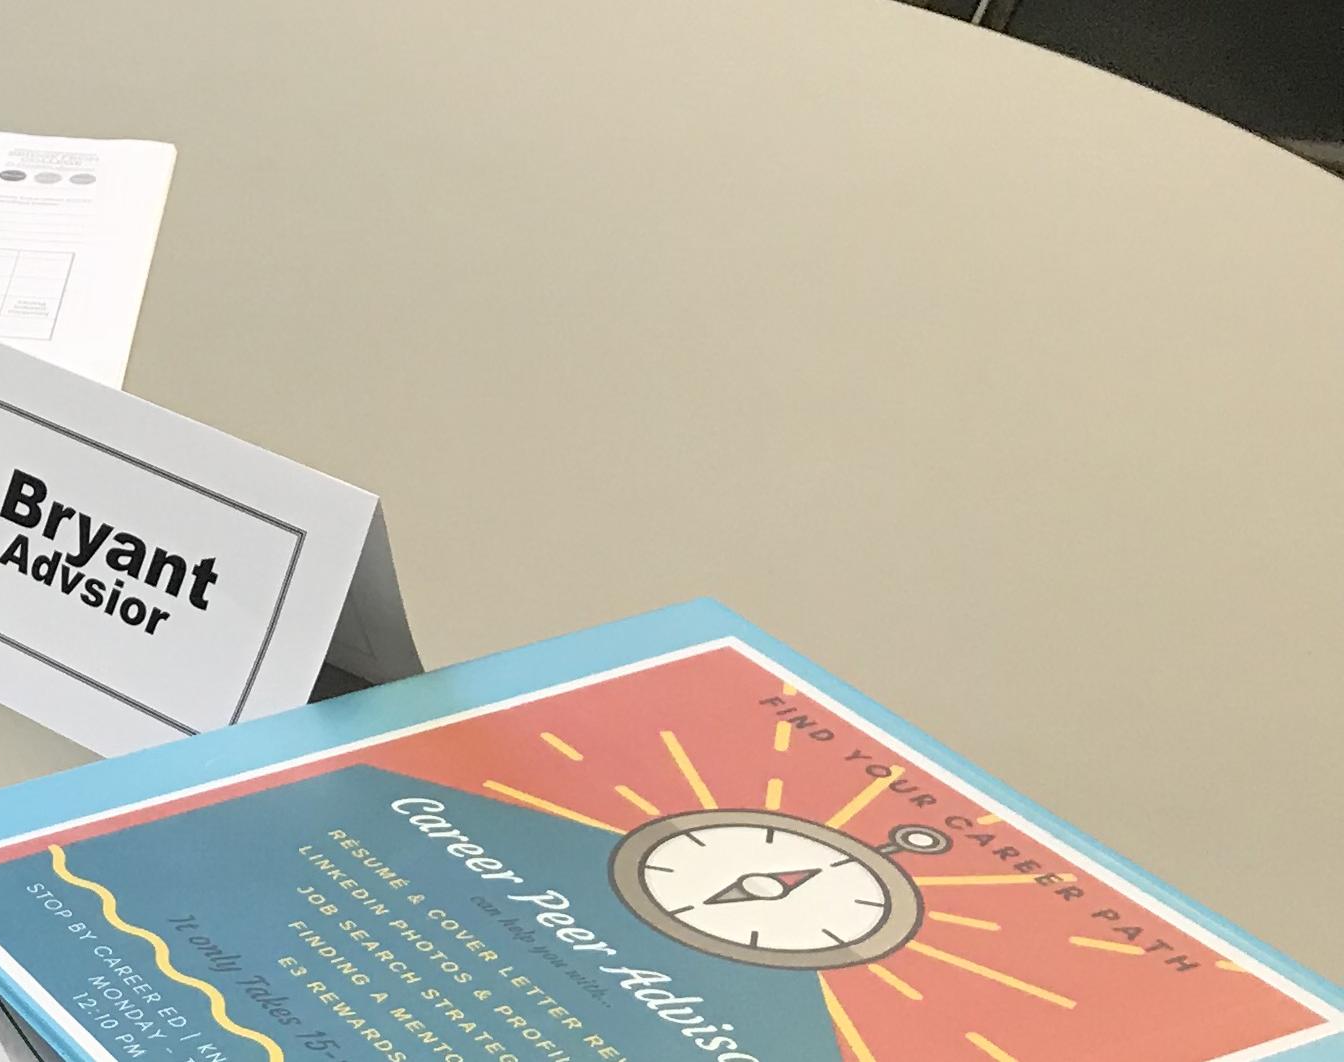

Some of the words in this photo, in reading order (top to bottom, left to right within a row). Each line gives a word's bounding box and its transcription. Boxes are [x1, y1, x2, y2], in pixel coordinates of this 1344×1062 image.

[390, 797, 524, 884] Career
[506, 889, 617, 957] Peer
[759, 696, 835, 742] FIND
[844, 749, 937, 808] YOUR
[944, 815, 1085, 902] CAREER
[1090, 908, 1201, 973] PATH
[26, 882, 73, 919] STOP
[68, 922, 97, 941] BY
[94, 945, 162, 1004] CAREER
[158, 1006, 187, 1028] ED
[168, 914, 199, 932] It
[188, 935, 243, 973] only
[236, 975, 301, 1026] Takes
[288, 920, 371, 986] FINDING
[370, 991, 389, 1003] A
[296, 886, 339, 916] JOB
[339, 919, 422, 984] SEARCH
[298, 845, 390, 916] LINKEDIN
[388, 919, 473, 983] PHOTOS
[472, 988, 492, 1002] &
[407, 893, 426, 905] &
[427, 909, 499, 962] COVER
[498, 966, 583, 1030] LETTER
[470, 895, 502, 918] can
[498, 917, 536, 945] help
[530, 945, 568, 969] you
[72, 991, 119, 1030] 12:10
[115, 1033, 145, 1058] PM
[88, 975, 167, 1041] MONDAY
[278, 956, 308, 977] E3
[307, 980, 407, 1062] REWARDS
